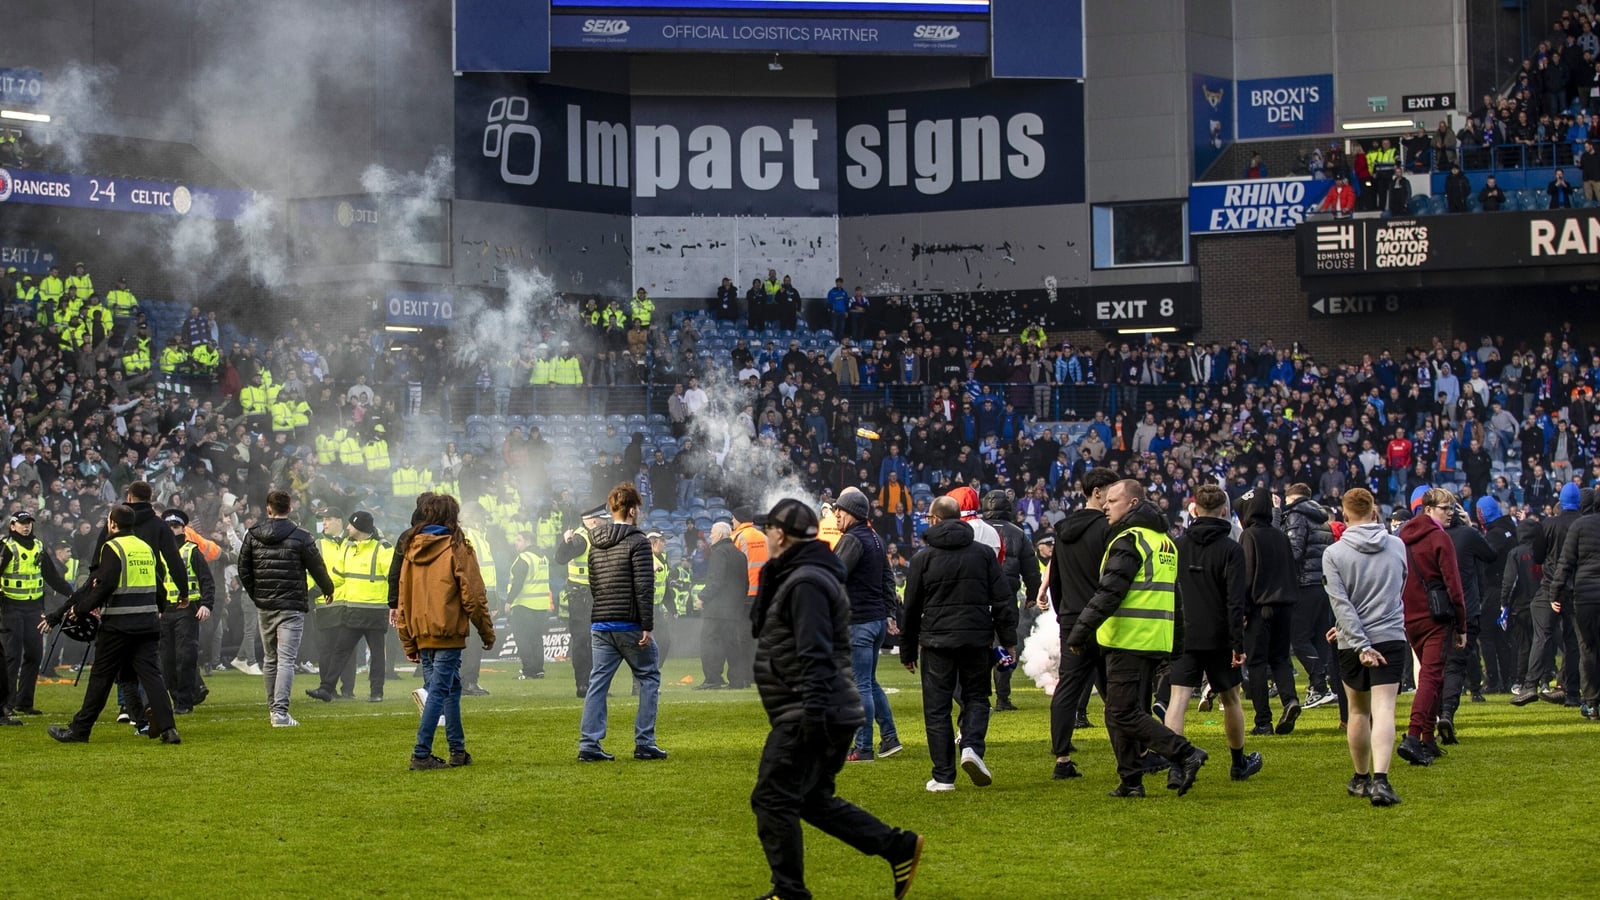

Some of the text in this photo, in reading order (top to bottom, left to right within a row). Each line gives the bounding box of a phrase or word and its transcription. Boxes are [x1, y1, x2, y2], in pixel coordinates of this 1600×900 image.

[582, 19, 630, 36] SEKO
[662, 25, 879, 42] OFFICIAL LOGISTICS PARTNER
[913, 24, 961, 41] SEKO
[0, 76, 15, 93] IT
[1251, 86, 1320, 107] BROXI'S
[1408, 96, 1450, 109] EXIT 8
[1267, 105, 1304, 123] DEN
[567, 103, 1046, 198] Impact signs
[13, 179, 171, 206] RANGERS 2-4 CELTIC
[1224, 182, 1305, 206] RHINO
[1375, 226, 1428, 242] PARK'S
[2, 247, 40, 264] EXIT 7
[1317, 252, 1355, 260] EDMISTON
[1376, 240, 1429, 255] MOTOR
[1317, 259, 1355, 270] HOUSE
[1376, 253, 1427, 268] GROUP
[403, 300, 429, 317] EXIT
[1096, 298, 1174, 319] EXIT 8
[1329, 295, 1400, 314] EXIT 8
